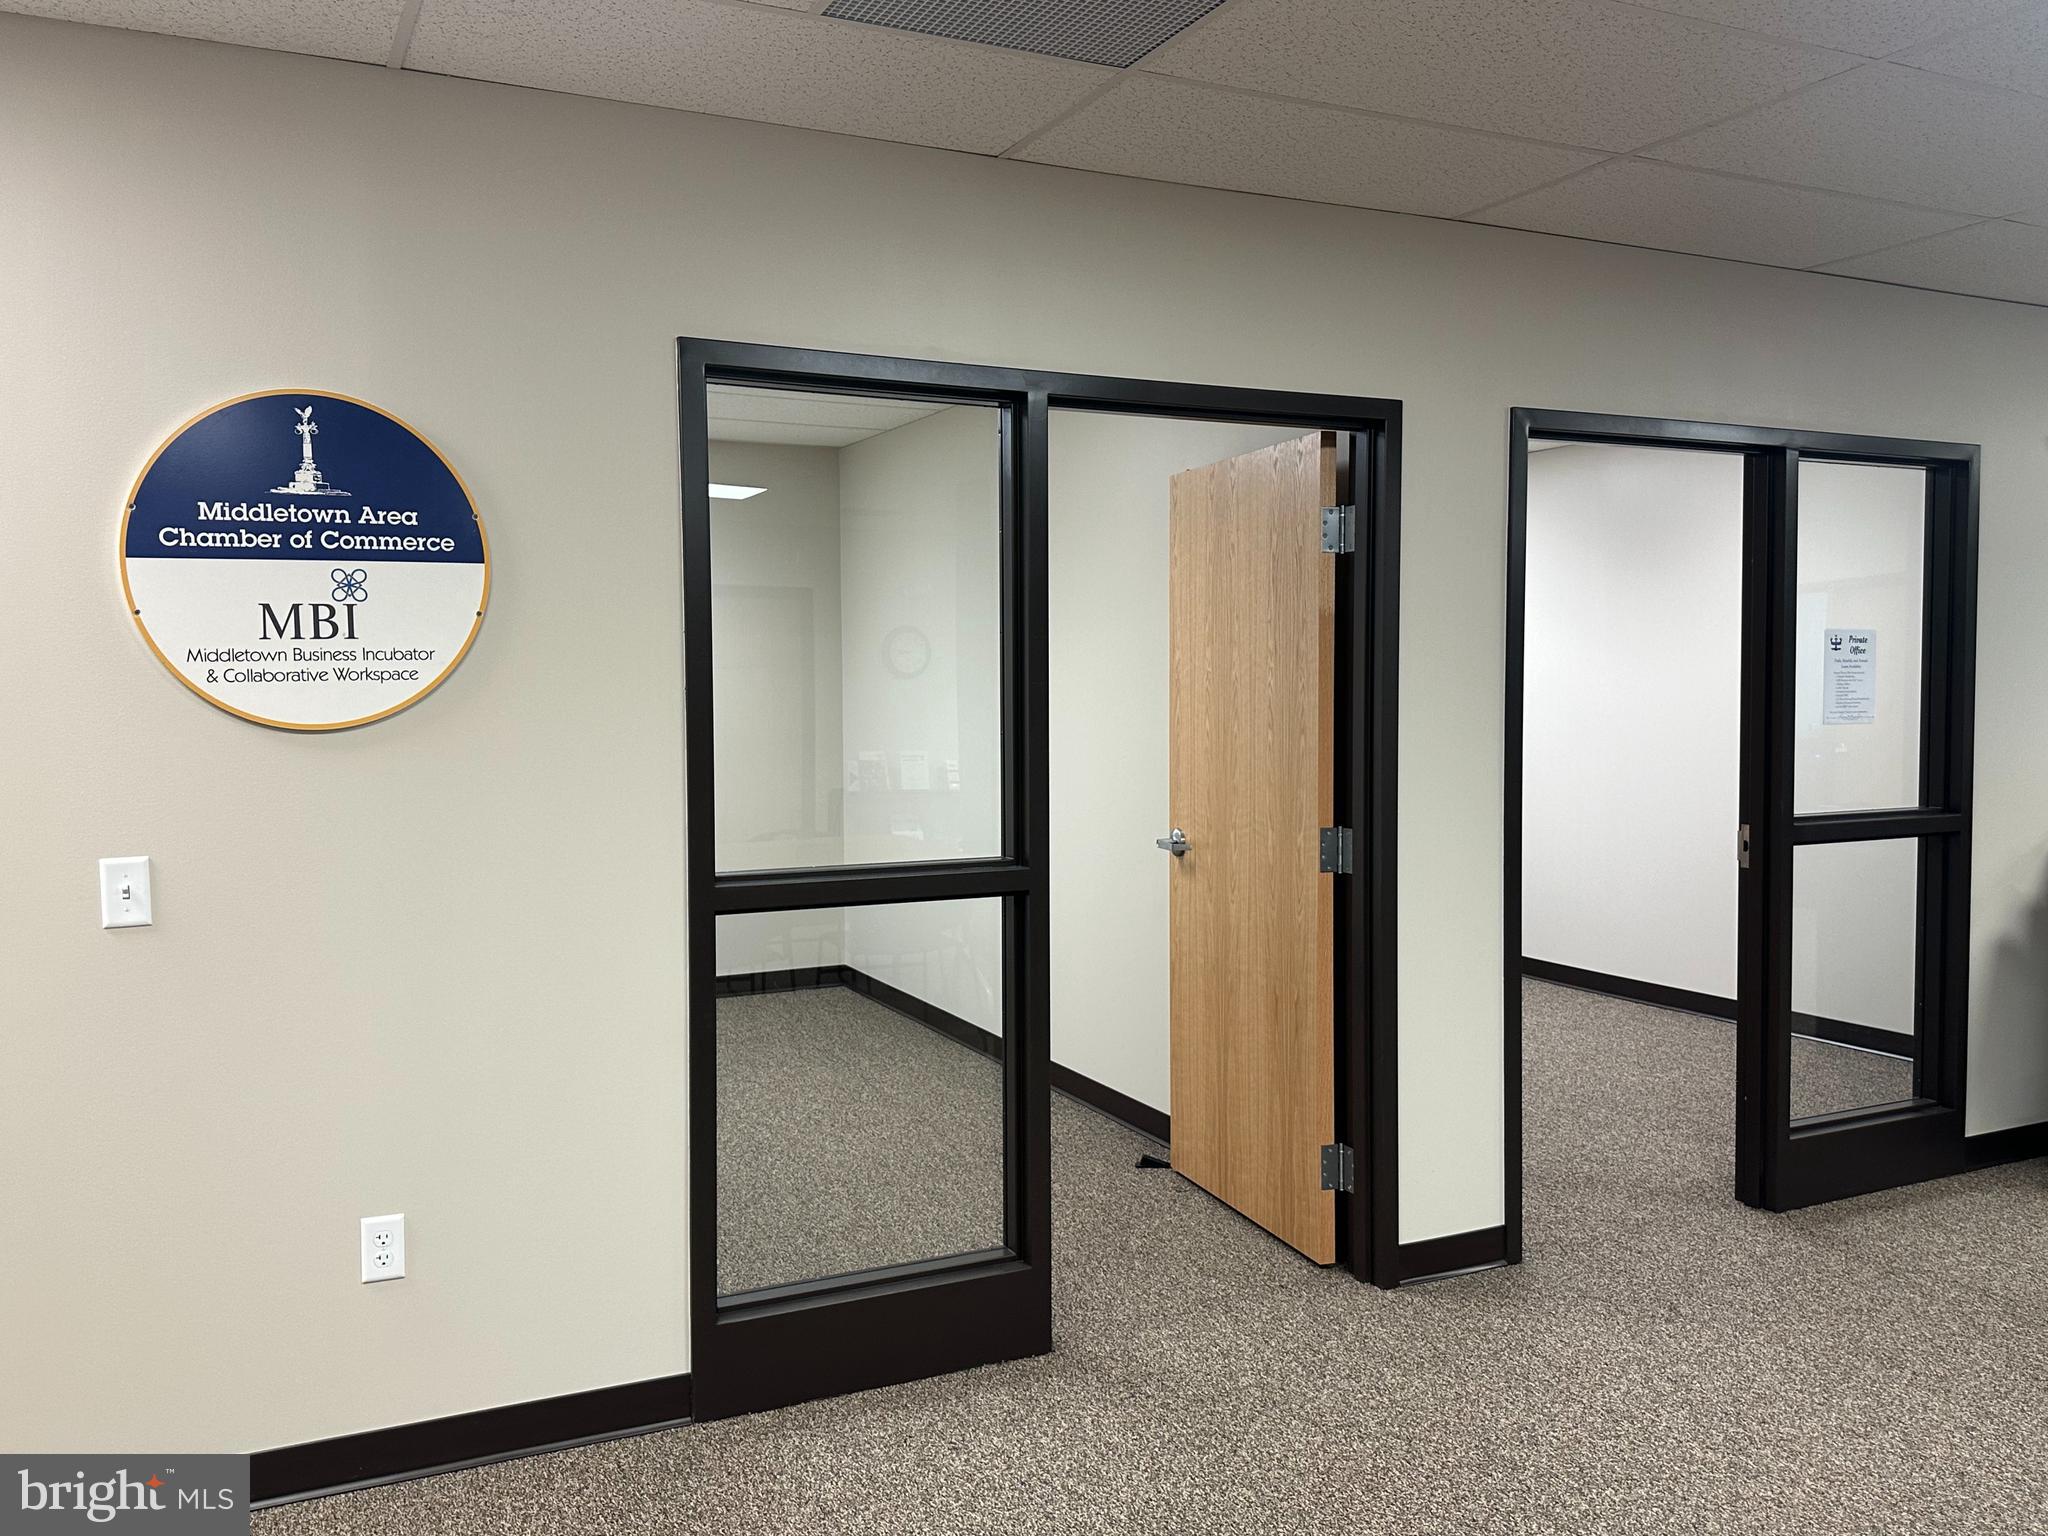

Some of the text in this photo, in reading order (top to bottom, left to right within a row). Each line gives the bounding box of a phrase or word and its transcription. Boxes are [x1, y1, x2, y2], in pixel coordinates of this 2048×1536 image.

[197, 501, 418, 526] Middletown Area
[158, 527, 455, 553] Chamber of Commerce
[257, 602, 359, 641] MBI
[1848, 635, 1868, 644] Private
[186, 647, 436, 663] Middletown Business Incubator
[1849, 646, 1866, 655] Office
[206, 667, 420, 684] & Collaborative Workspace
